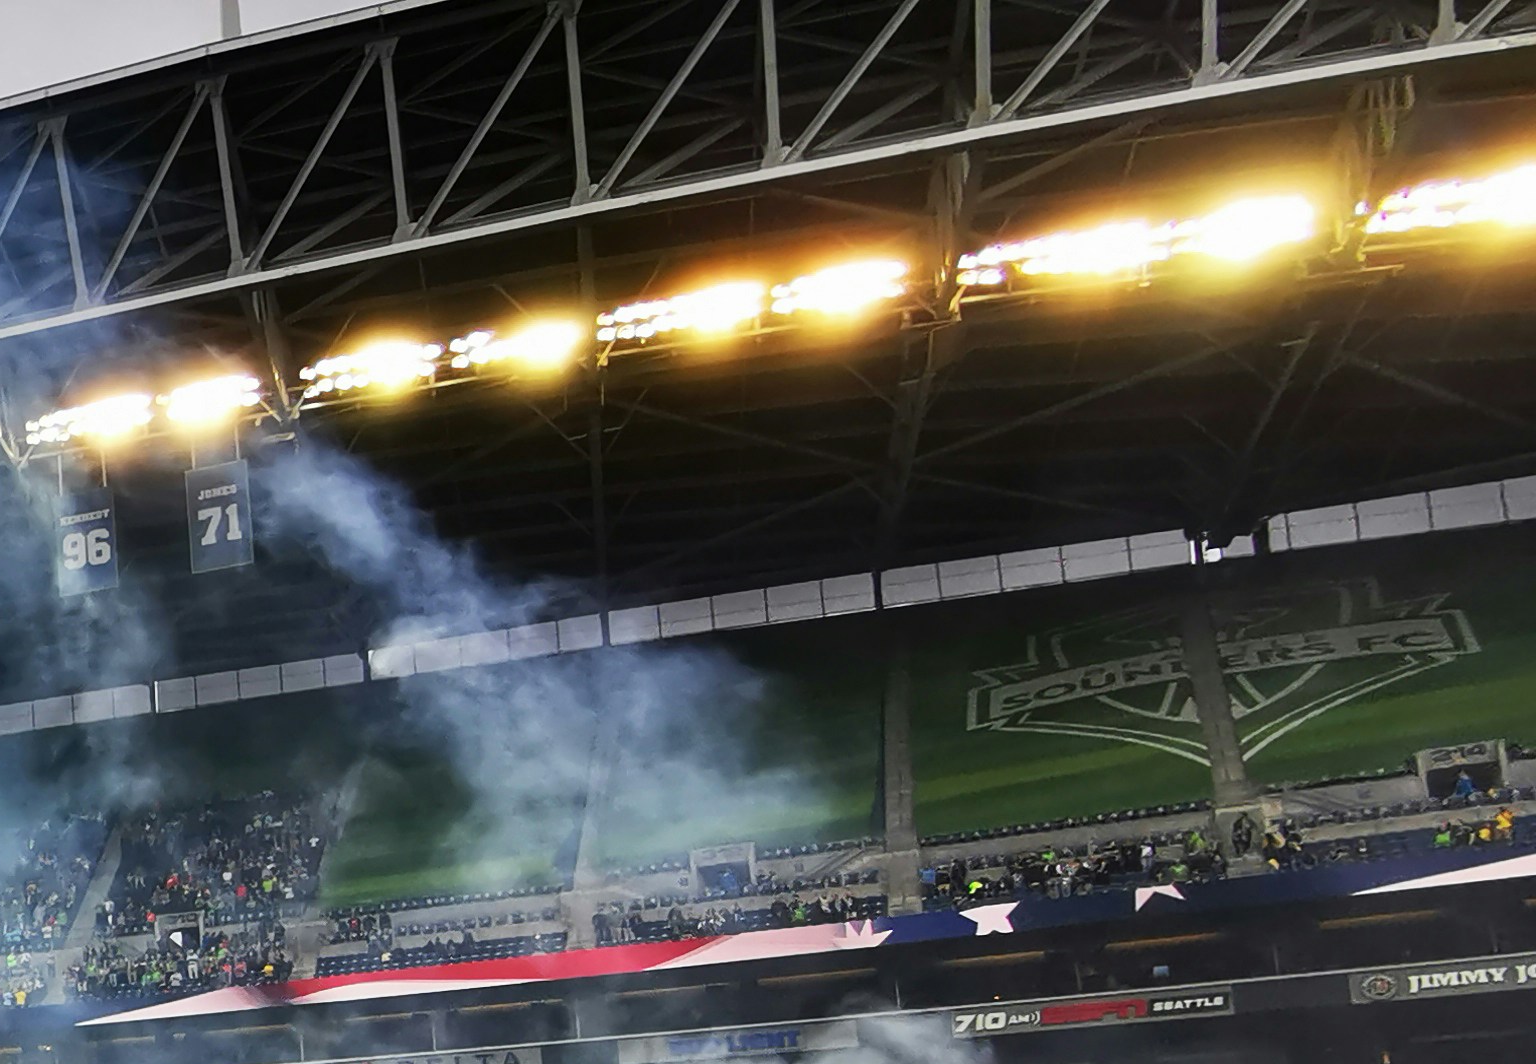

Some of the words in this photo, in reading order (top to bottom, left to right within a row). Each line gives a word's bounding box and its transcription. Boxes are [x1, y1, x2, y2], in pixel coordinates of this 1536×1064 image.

[196, 503, 243, 546] 71
[62, 528, 112, 570] 96
[1407, 967, 1508, 994] JIMMY
[953, 1011, 1007, 1033] 710
[1152, 996, 1224, 1012] SEATTLE
